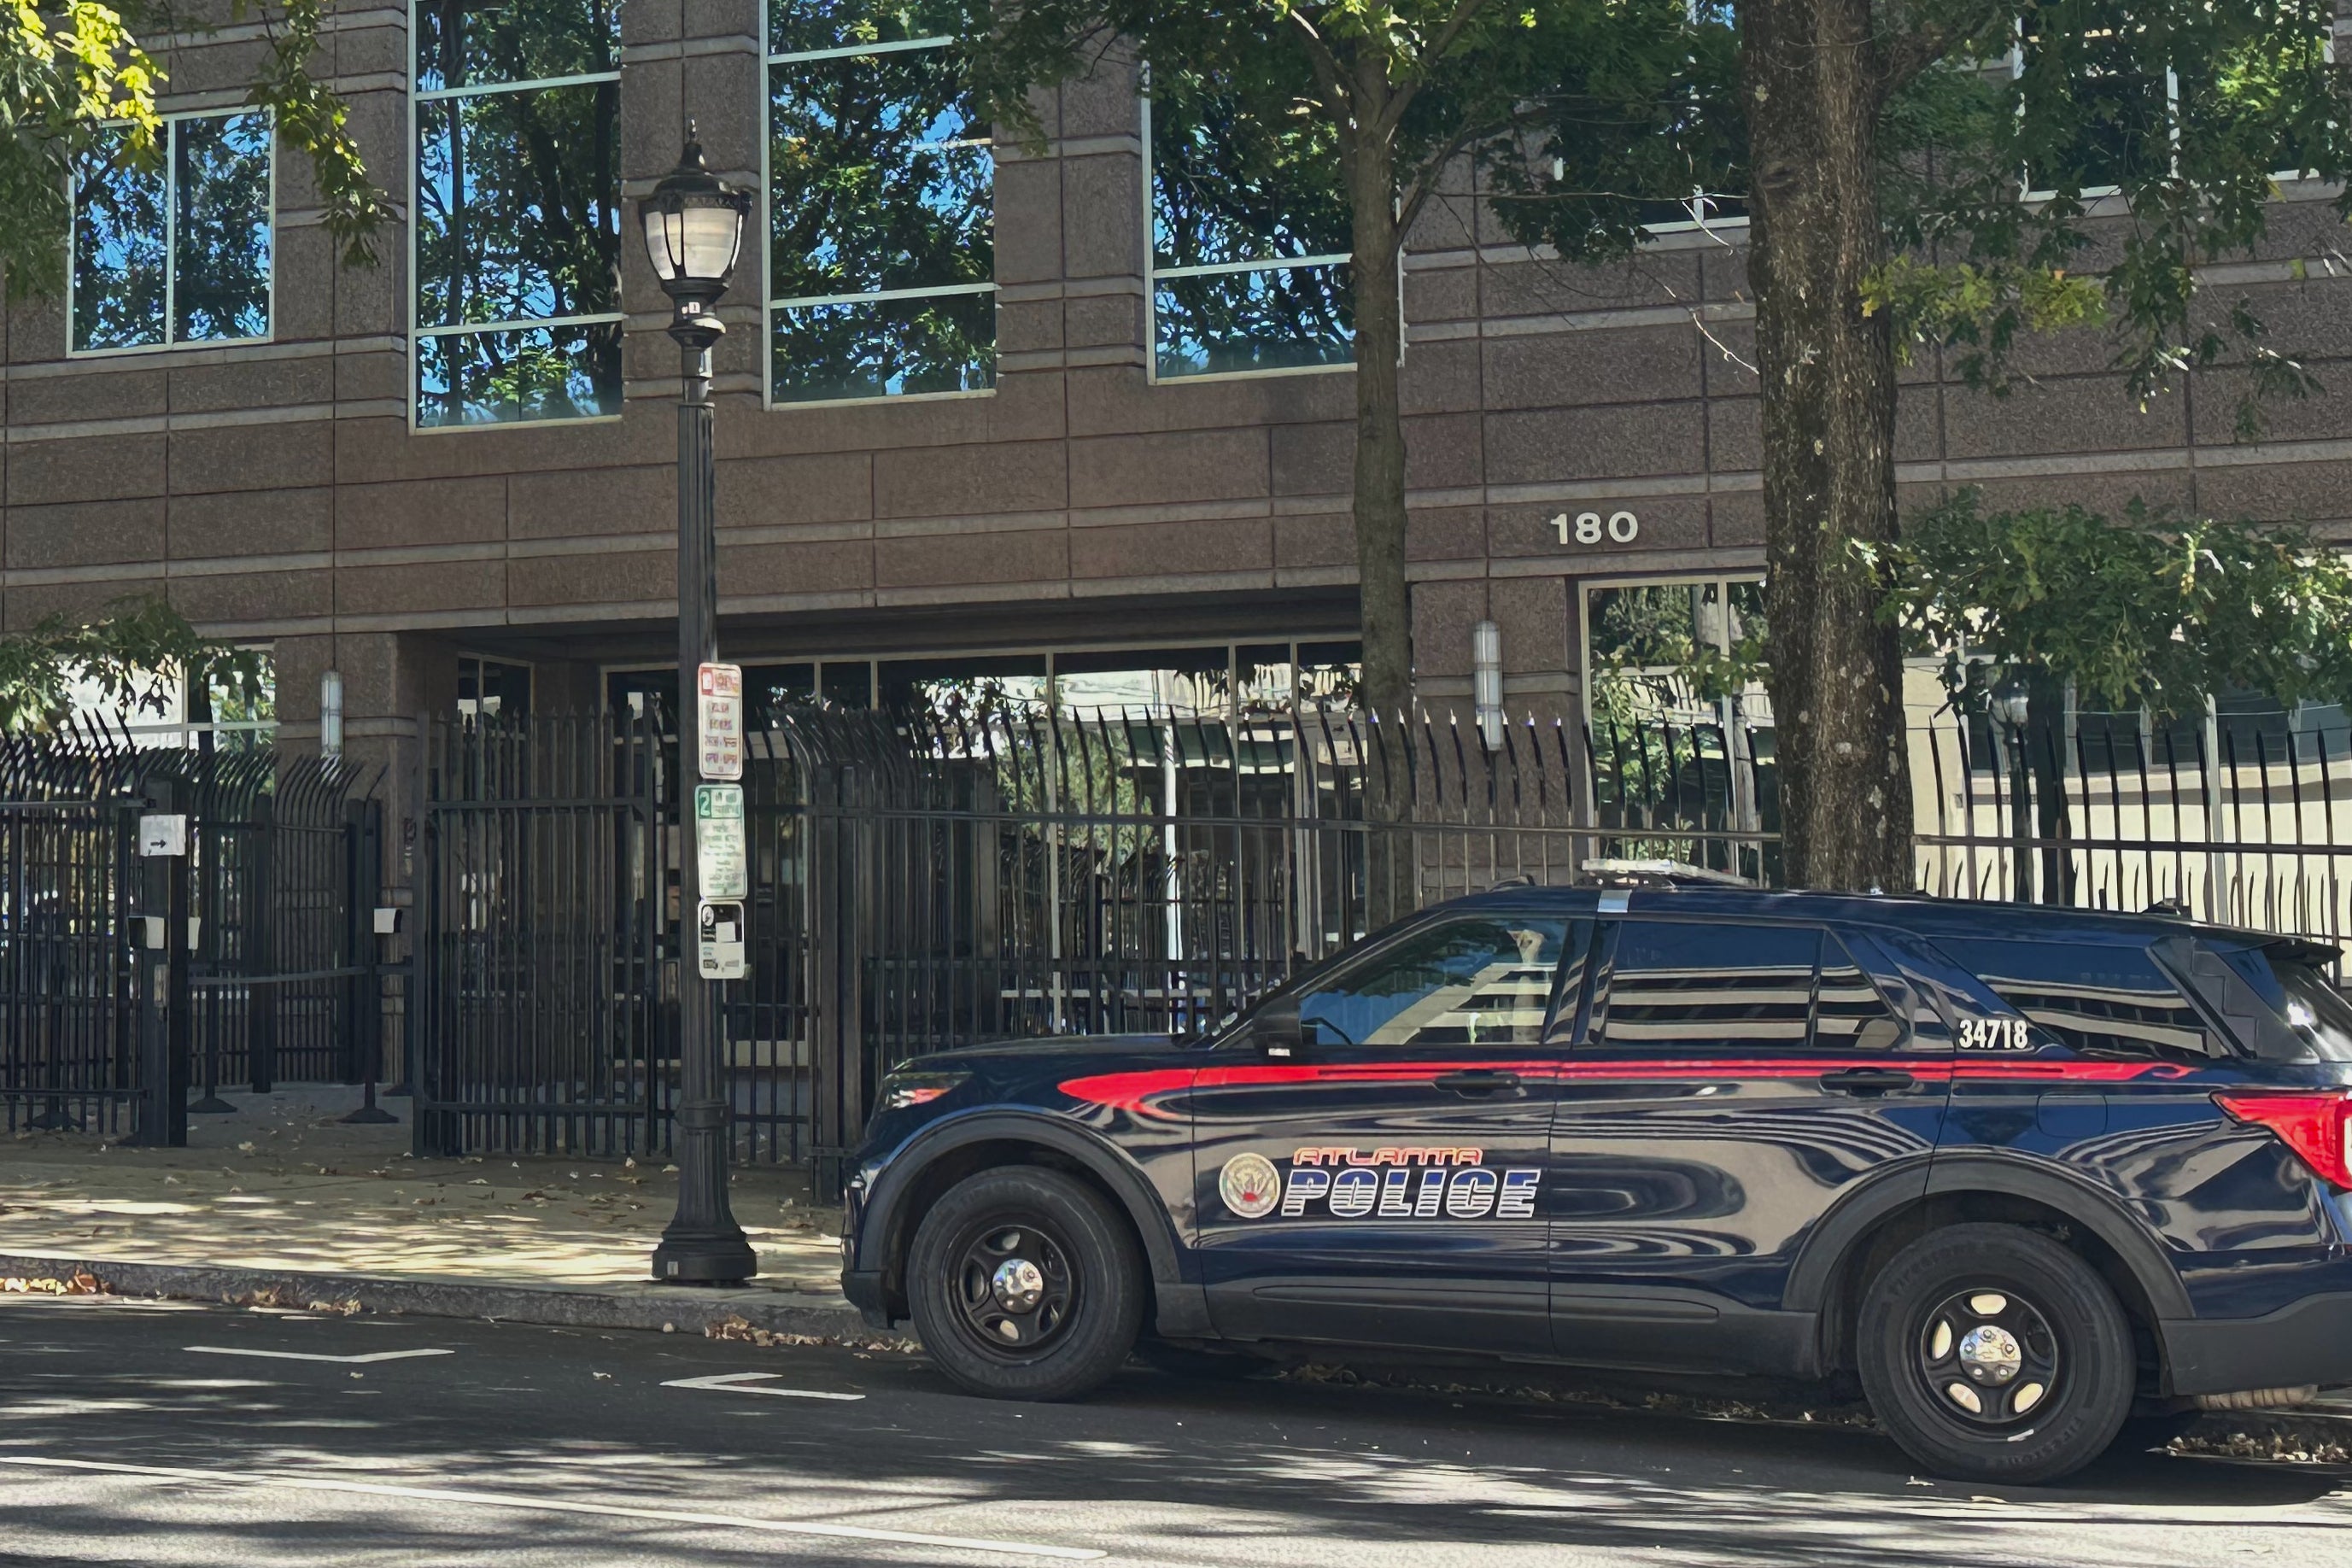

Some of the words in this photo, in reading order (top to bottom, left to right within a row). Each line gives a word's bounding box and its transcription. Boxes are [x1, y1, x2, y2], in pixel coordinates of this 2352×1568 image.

[1550, 512, 1638, 544] 180
[699, 791, 711, 816] 2
[1958, 1019, 2028, 1049] 34718
[1292, 1147, 1483, 1167] ATLANTA
[1281, 1167, 1542, 1219] POLICE
